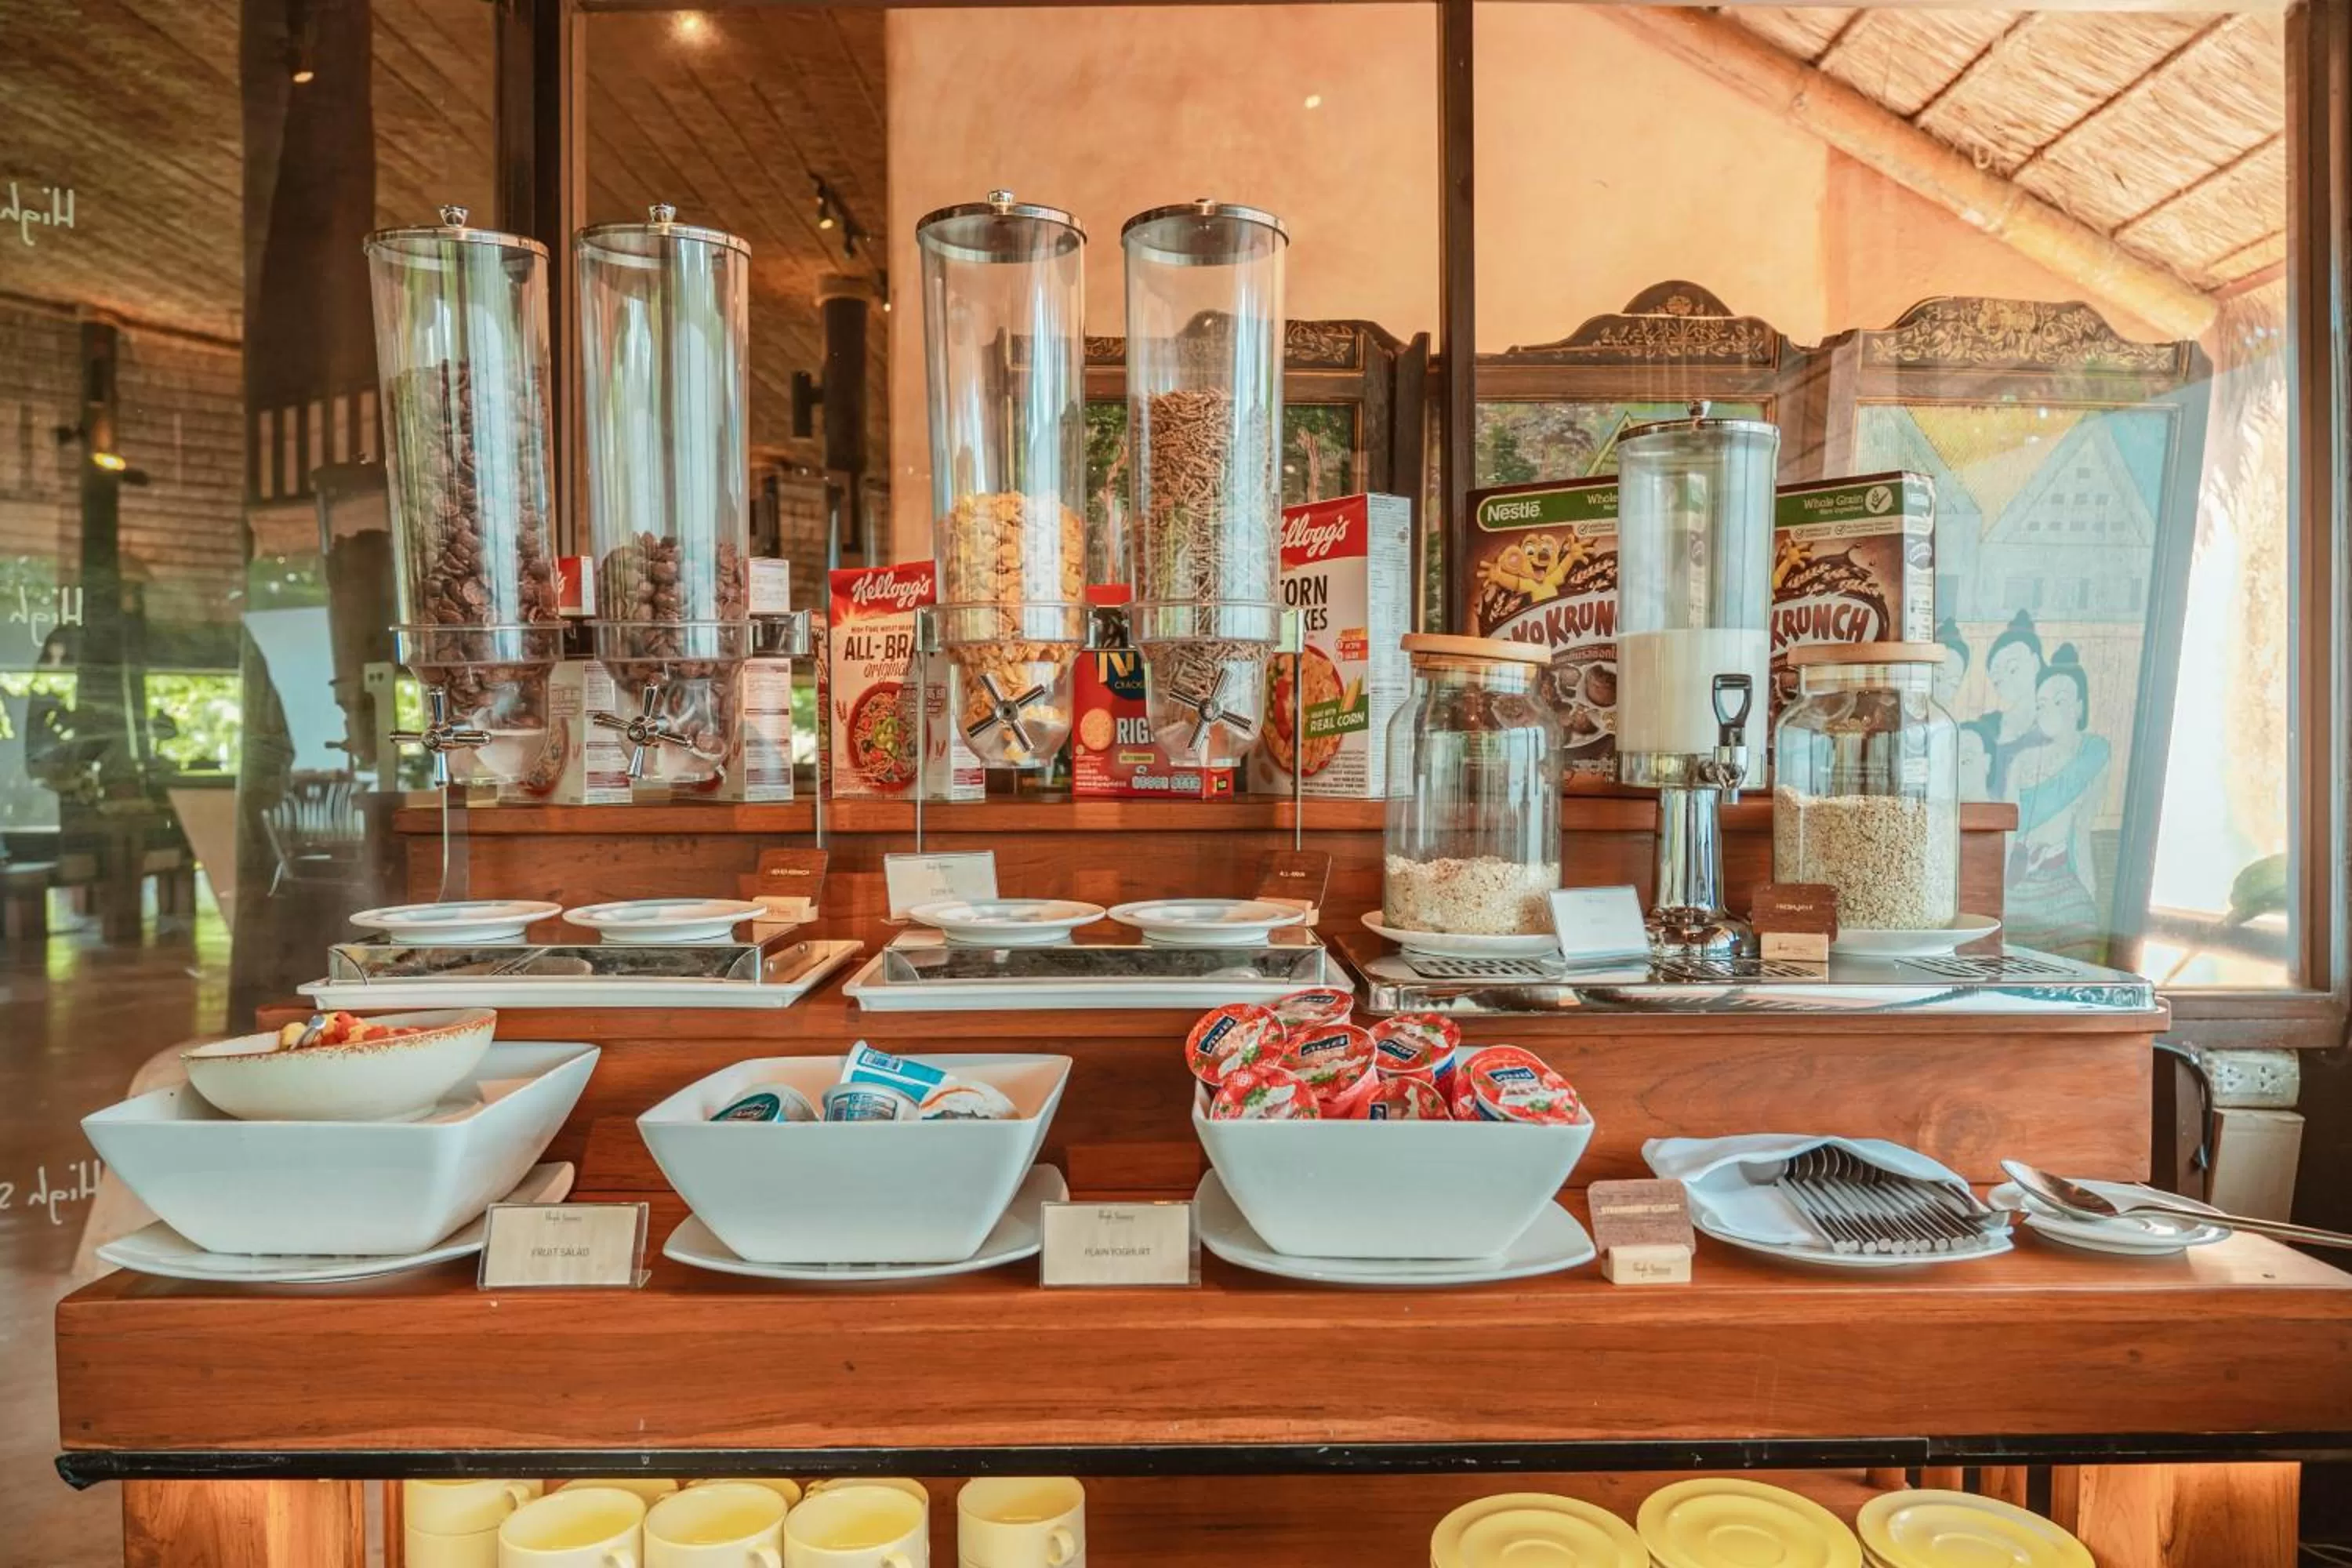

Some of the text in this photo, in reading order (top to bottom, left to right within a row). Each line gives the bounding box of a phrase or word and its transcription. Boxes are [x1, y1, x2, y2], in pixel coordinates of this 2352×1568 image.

[1802, 494, 1864, 510] Whole Grain
[1280, 514, 1351, 557] ellogg's
[851, 571, 932, 609] Kellogg's
[1280, 574, 1328, 607] ORN
[1304, 608, 1328, 632] KES
[1116, 717, 1155, 745] RIG
[1310, 711, 1365, 733] REAL CORN
[560, 1247, 590, 1257] SALAD
[1084, 1247, 1109, 1257] PLAIN
